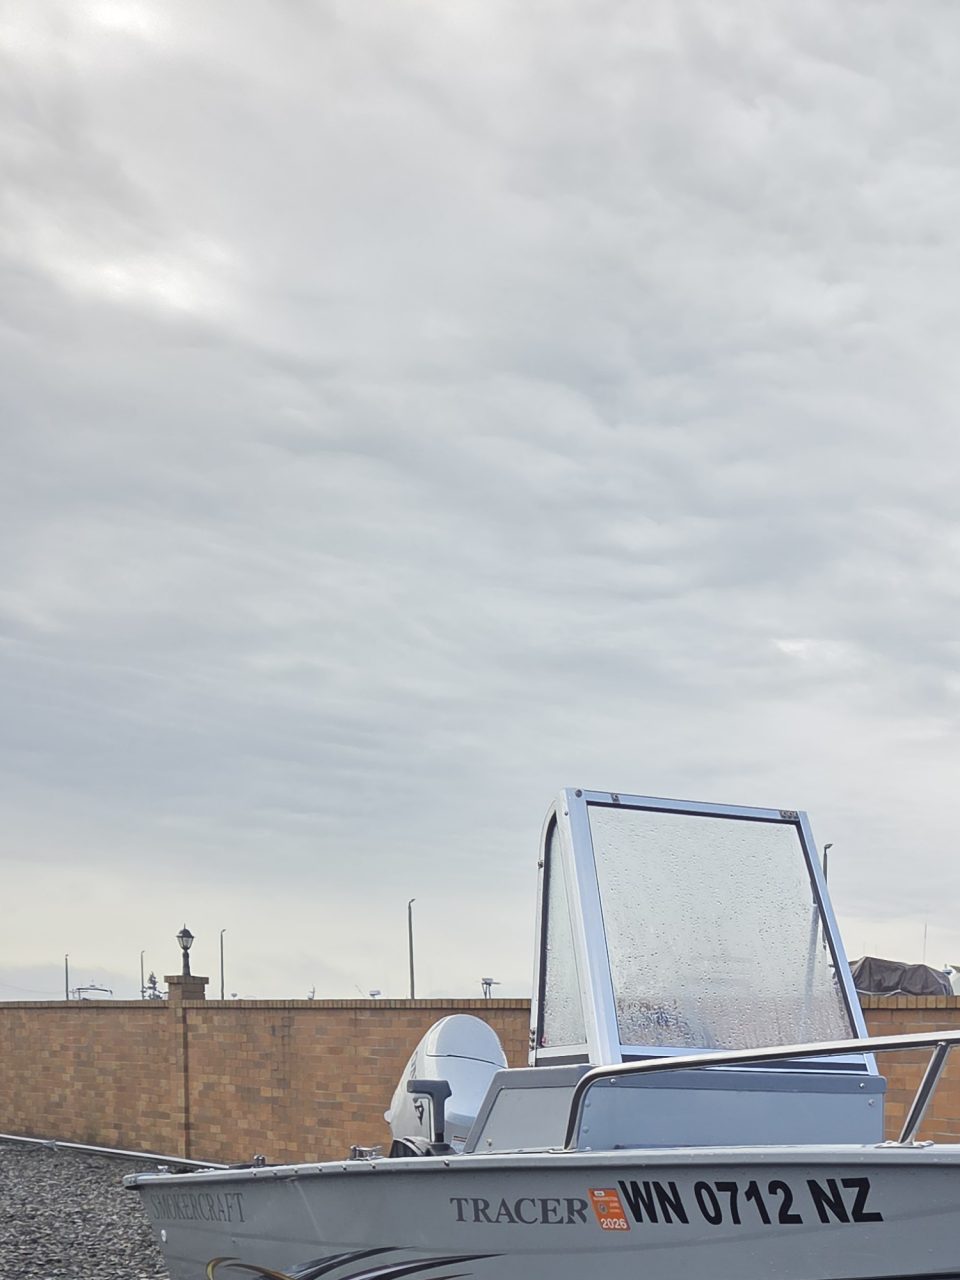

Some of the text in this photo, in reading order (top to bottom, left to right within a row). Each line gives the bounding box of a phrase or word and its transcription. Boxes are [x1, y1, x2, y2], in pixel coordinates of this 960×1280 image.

[449, 1197, 588, 1224] TRACER
[617, 1180, 690, 1224] WN
[694, 1179, 804, 1226] 0712
[806, 1177, 884, 1224] NZ
[600, 1217, 628, 1229] 2026
